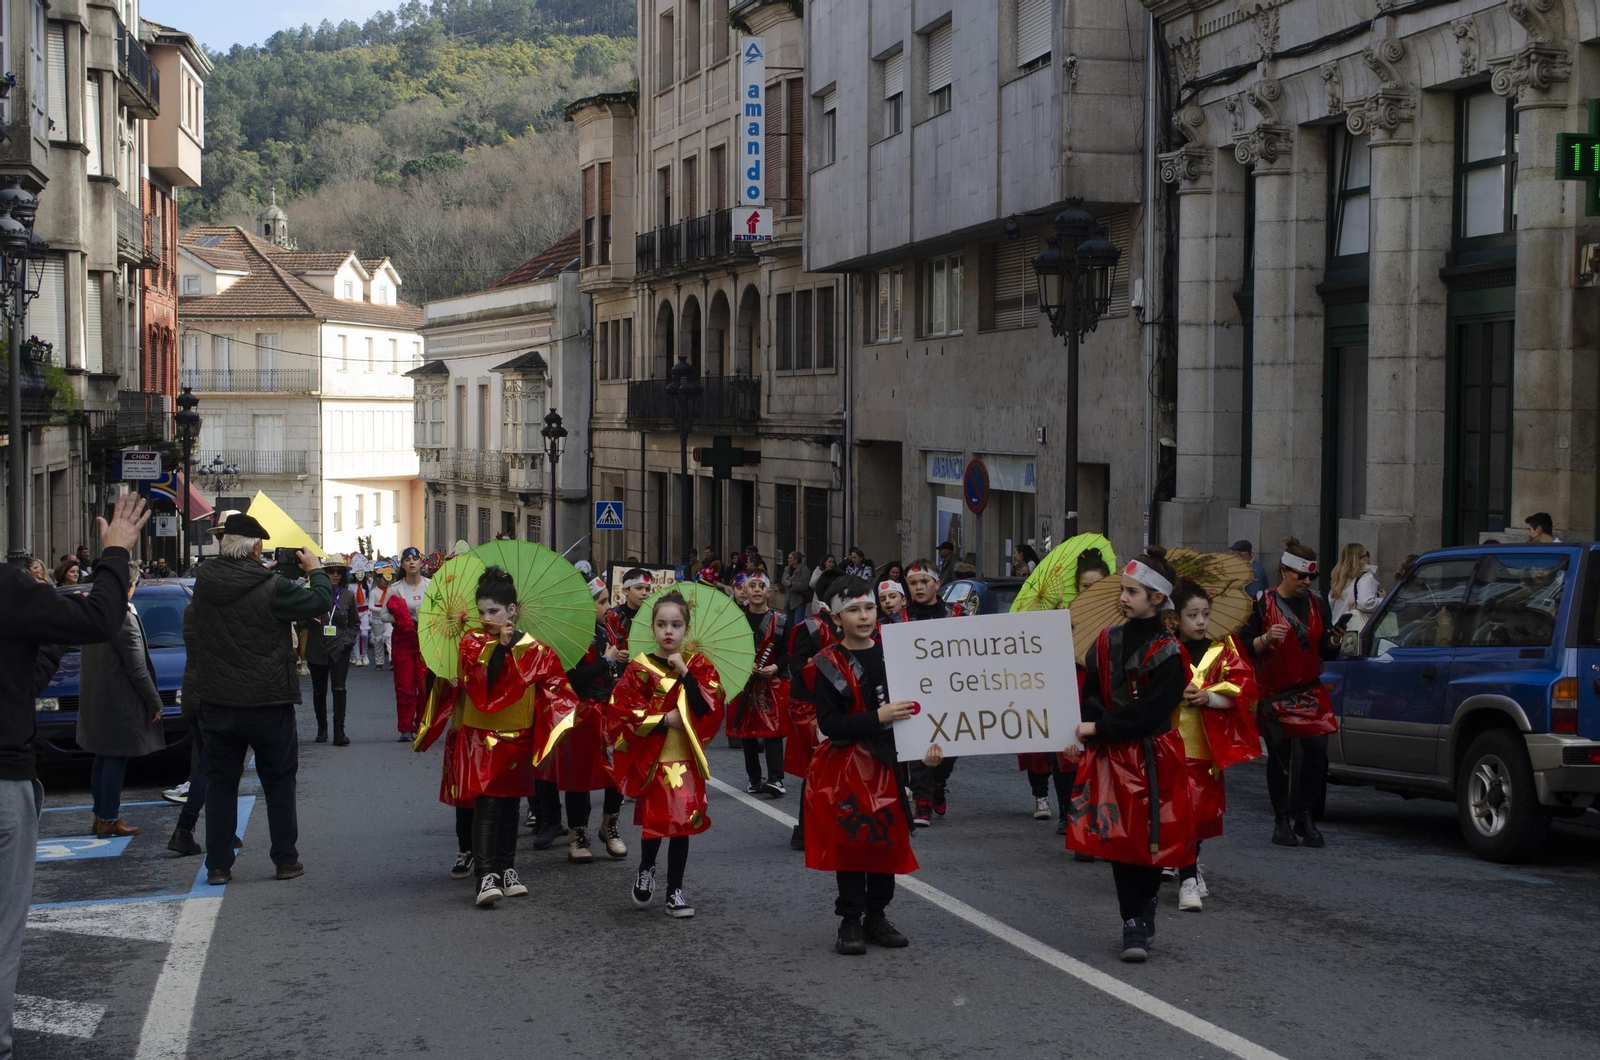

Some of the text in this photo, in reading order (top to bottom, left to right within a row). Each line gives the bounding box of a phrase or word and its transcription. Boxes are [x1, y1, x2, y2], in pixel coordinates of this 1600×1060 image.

[745, 84, 762, 200] amando
[914, 631, 1043, 660] Samurais
[919, 668, 1046, 694] e Geishas
[926, 701, 1050, 743] XAPÓN
